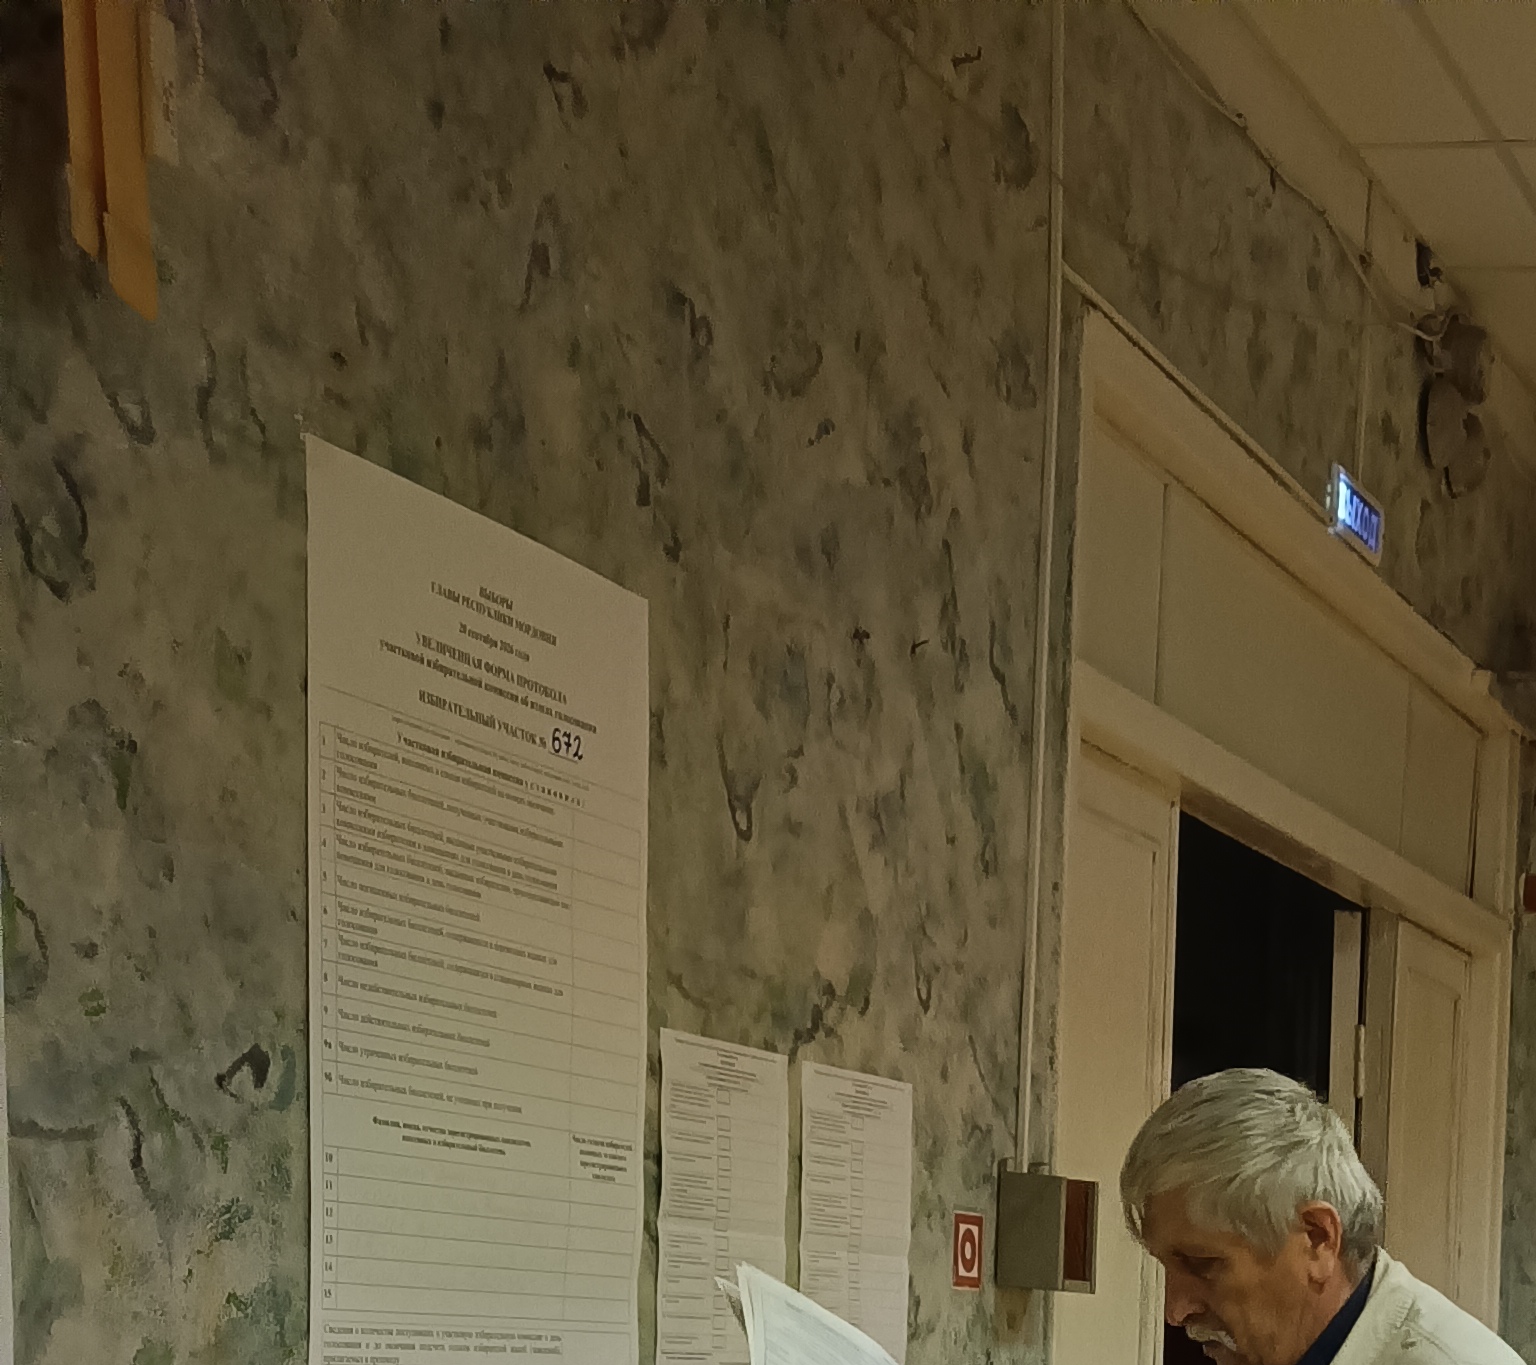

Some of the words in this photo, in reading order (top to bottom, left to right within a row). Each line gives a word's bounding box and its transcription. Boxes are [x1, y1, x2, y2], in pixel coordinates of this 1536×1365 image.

[430, 580, 460, 605] ГЛАВЫ
[461, 594, 513, 629] РЕСПУБЛИКИ
[514, 617, 556, 648] МОРДОВИИ
[478, 584, 513, 611] ВЫБОРЫ
[414, 630, 483, 672] УВЕЛИЧЕННАЯ
[483, 659, 517, 685] ФОРМА
[516, 673, 566, 706] ПРОТОКОЛА
[418, 685, 495, 730] ИЗБИРАТЕЛЬНЫЙ
[496, 718, 537, 746] УЧАСТОК
[551, 724, 583, 763] 672
